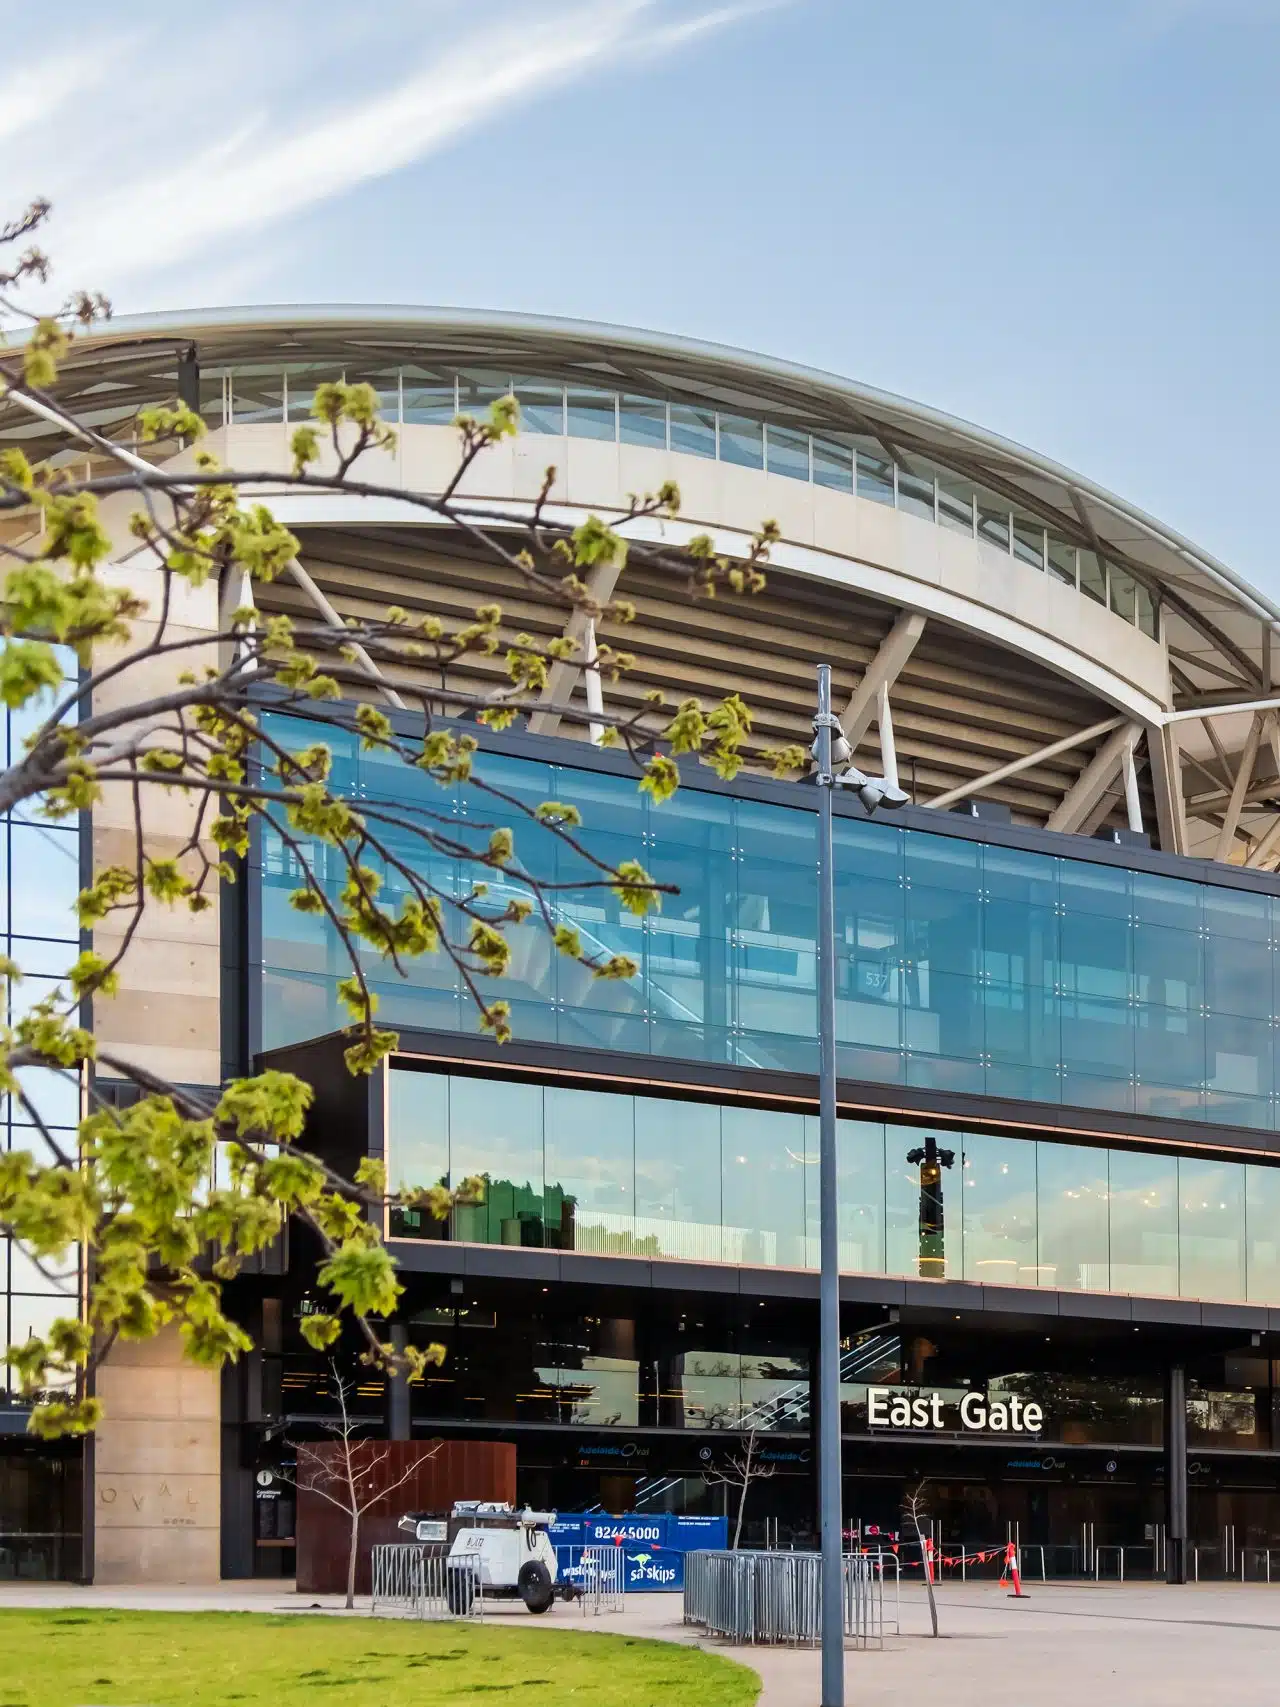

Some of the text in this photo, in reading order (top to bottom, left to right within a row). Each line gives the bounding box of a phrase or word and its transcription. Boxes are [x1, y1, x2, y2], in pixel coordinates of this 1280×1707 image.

[866, 972, 888, 988] 537
[868, 1388, 1043, 1431] East Gate
[594, 1526, 660, 1540] 82445000
[630, 1564, 676, 1584] sa skips
